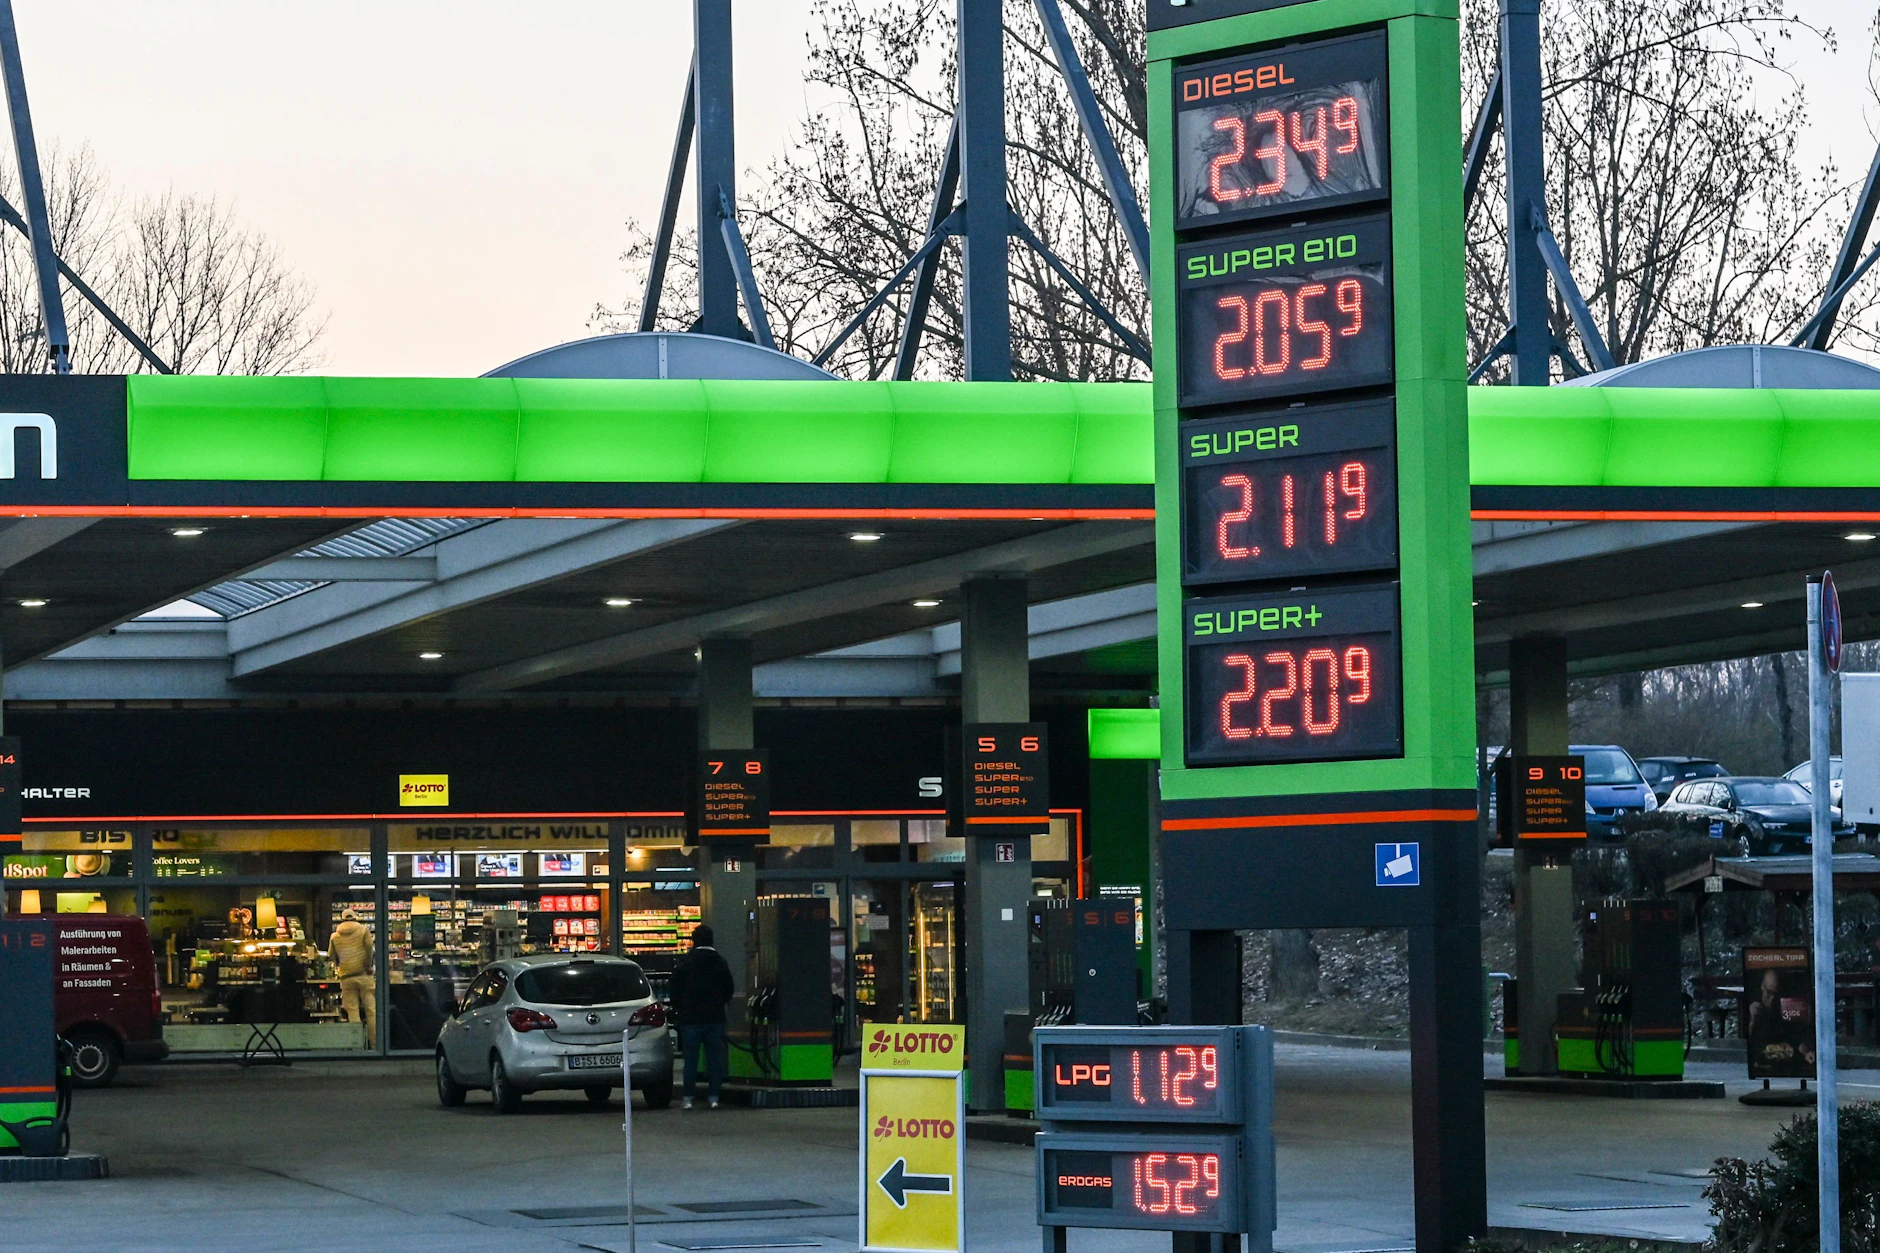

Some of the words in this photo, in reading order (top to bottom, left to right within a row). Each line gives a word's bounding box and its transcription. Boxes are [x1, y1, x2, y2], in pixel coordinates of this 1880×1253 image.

[1183, 63, 1295, 102] DIESEL
[1187, 243, 1295, 280] SUPER
[1190, 424, 1299, 457] SUPER
[1194, 604, 1323, 636] SUPER+
[978, 737, 996, 752] 5
[1021, 736, 1039, 752] 6
[708, 761, 724, 775] 7
[745, 761, 762, 775] 8
[974, 762, 1021, 770] DIESEL
[1528, 767, 1544, 780] 9
[1560, 767, 1582, 780] 10
[414, 784, 444, 793] LOTTO
[974, 785, 1019, 794] SUPER
[60, 929, 106, 940] Ausführung
[107, 930, 122, 938] von
[61, 944, 117, 955] Malerarbeiten
[61, 962, 70, 972] in
[71, 961, 104, 972] Räumen
[105, 961, 112, 971] &
[62, 980, 73, 988] an
[74, 978, 112, 988] Fassaden
[894, 1032, 954, 1054] LOTTO
[893, 1058, 911, 1066] Berlin
[1055, 1064, 1112, 1087] LPG
[897, 1118, 955, 1139] LOTTO
[1058, 1175, 1113, 1188] ERDGAS
